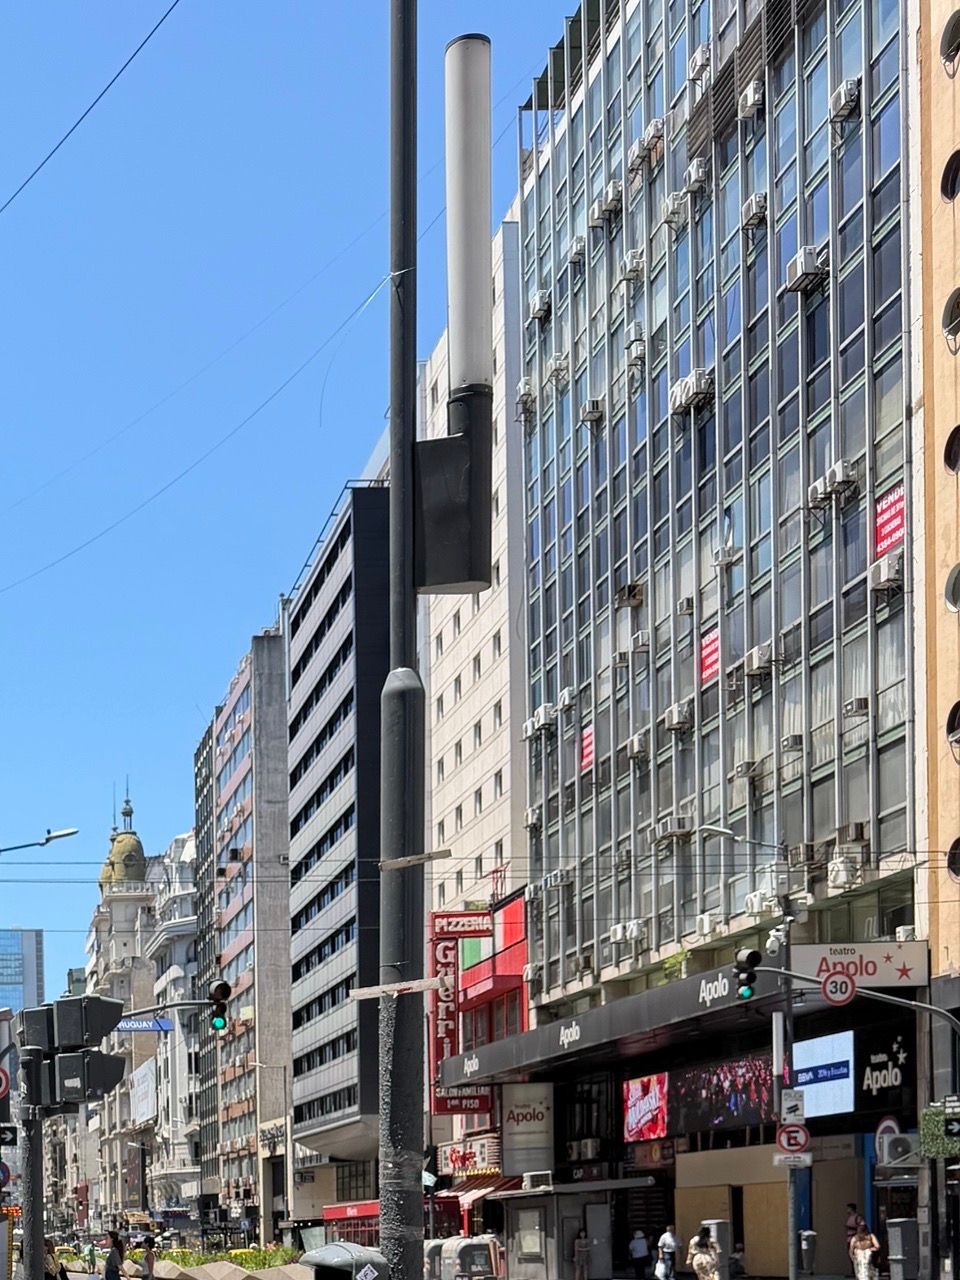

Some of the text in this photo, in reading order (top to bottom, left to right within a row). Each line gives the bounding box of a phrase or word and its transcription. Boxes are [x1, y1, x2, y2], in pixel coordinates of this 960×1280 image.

[435, 915, 493, 933] PIZZERIA
[829, 947, 856, 956] teatro
[699, 973, 729, 1007] Apolo
[829, 980, 848, 995] 30
[436, 941, 455, 1059] Güerri
[559, 1021, 580, 1049] Apolo
[463, 1054, 479, 1077] Apolo
[797, 1072, 814, 1083] BBVA
[862, 1061, 901, 1096] Apolo
[462, 1099, 479, 1109] PISO
[506, 1108, 544, 1126] Apolo
